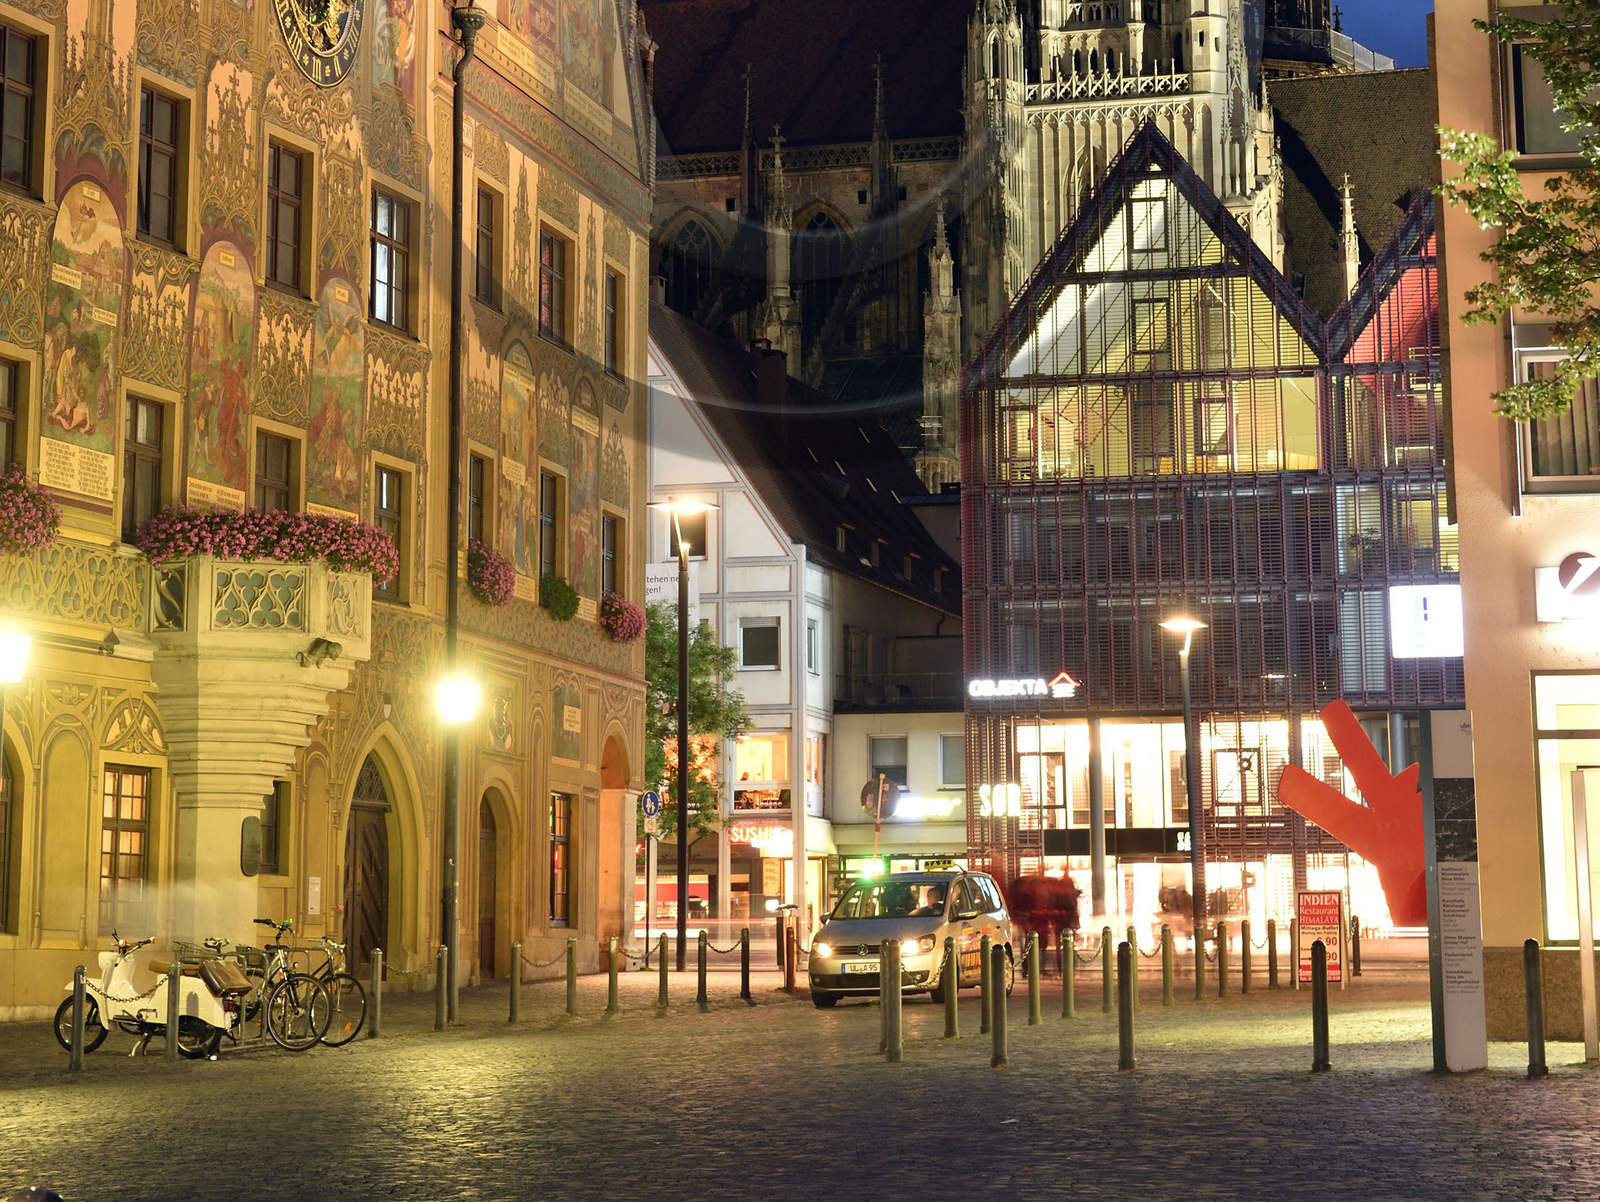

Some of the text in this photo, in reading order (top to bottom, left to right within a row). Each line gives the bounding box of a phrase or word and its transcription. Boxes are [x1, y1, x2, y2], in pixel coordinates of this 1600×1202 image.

[968, 678, 1048, 697] OBJEKTA
[1300, 894, 1339, 906] INDIEN
[1300, 906, 1339, 915] Restaurant
[1300, 916, 1339, 924] HIMALAYA
